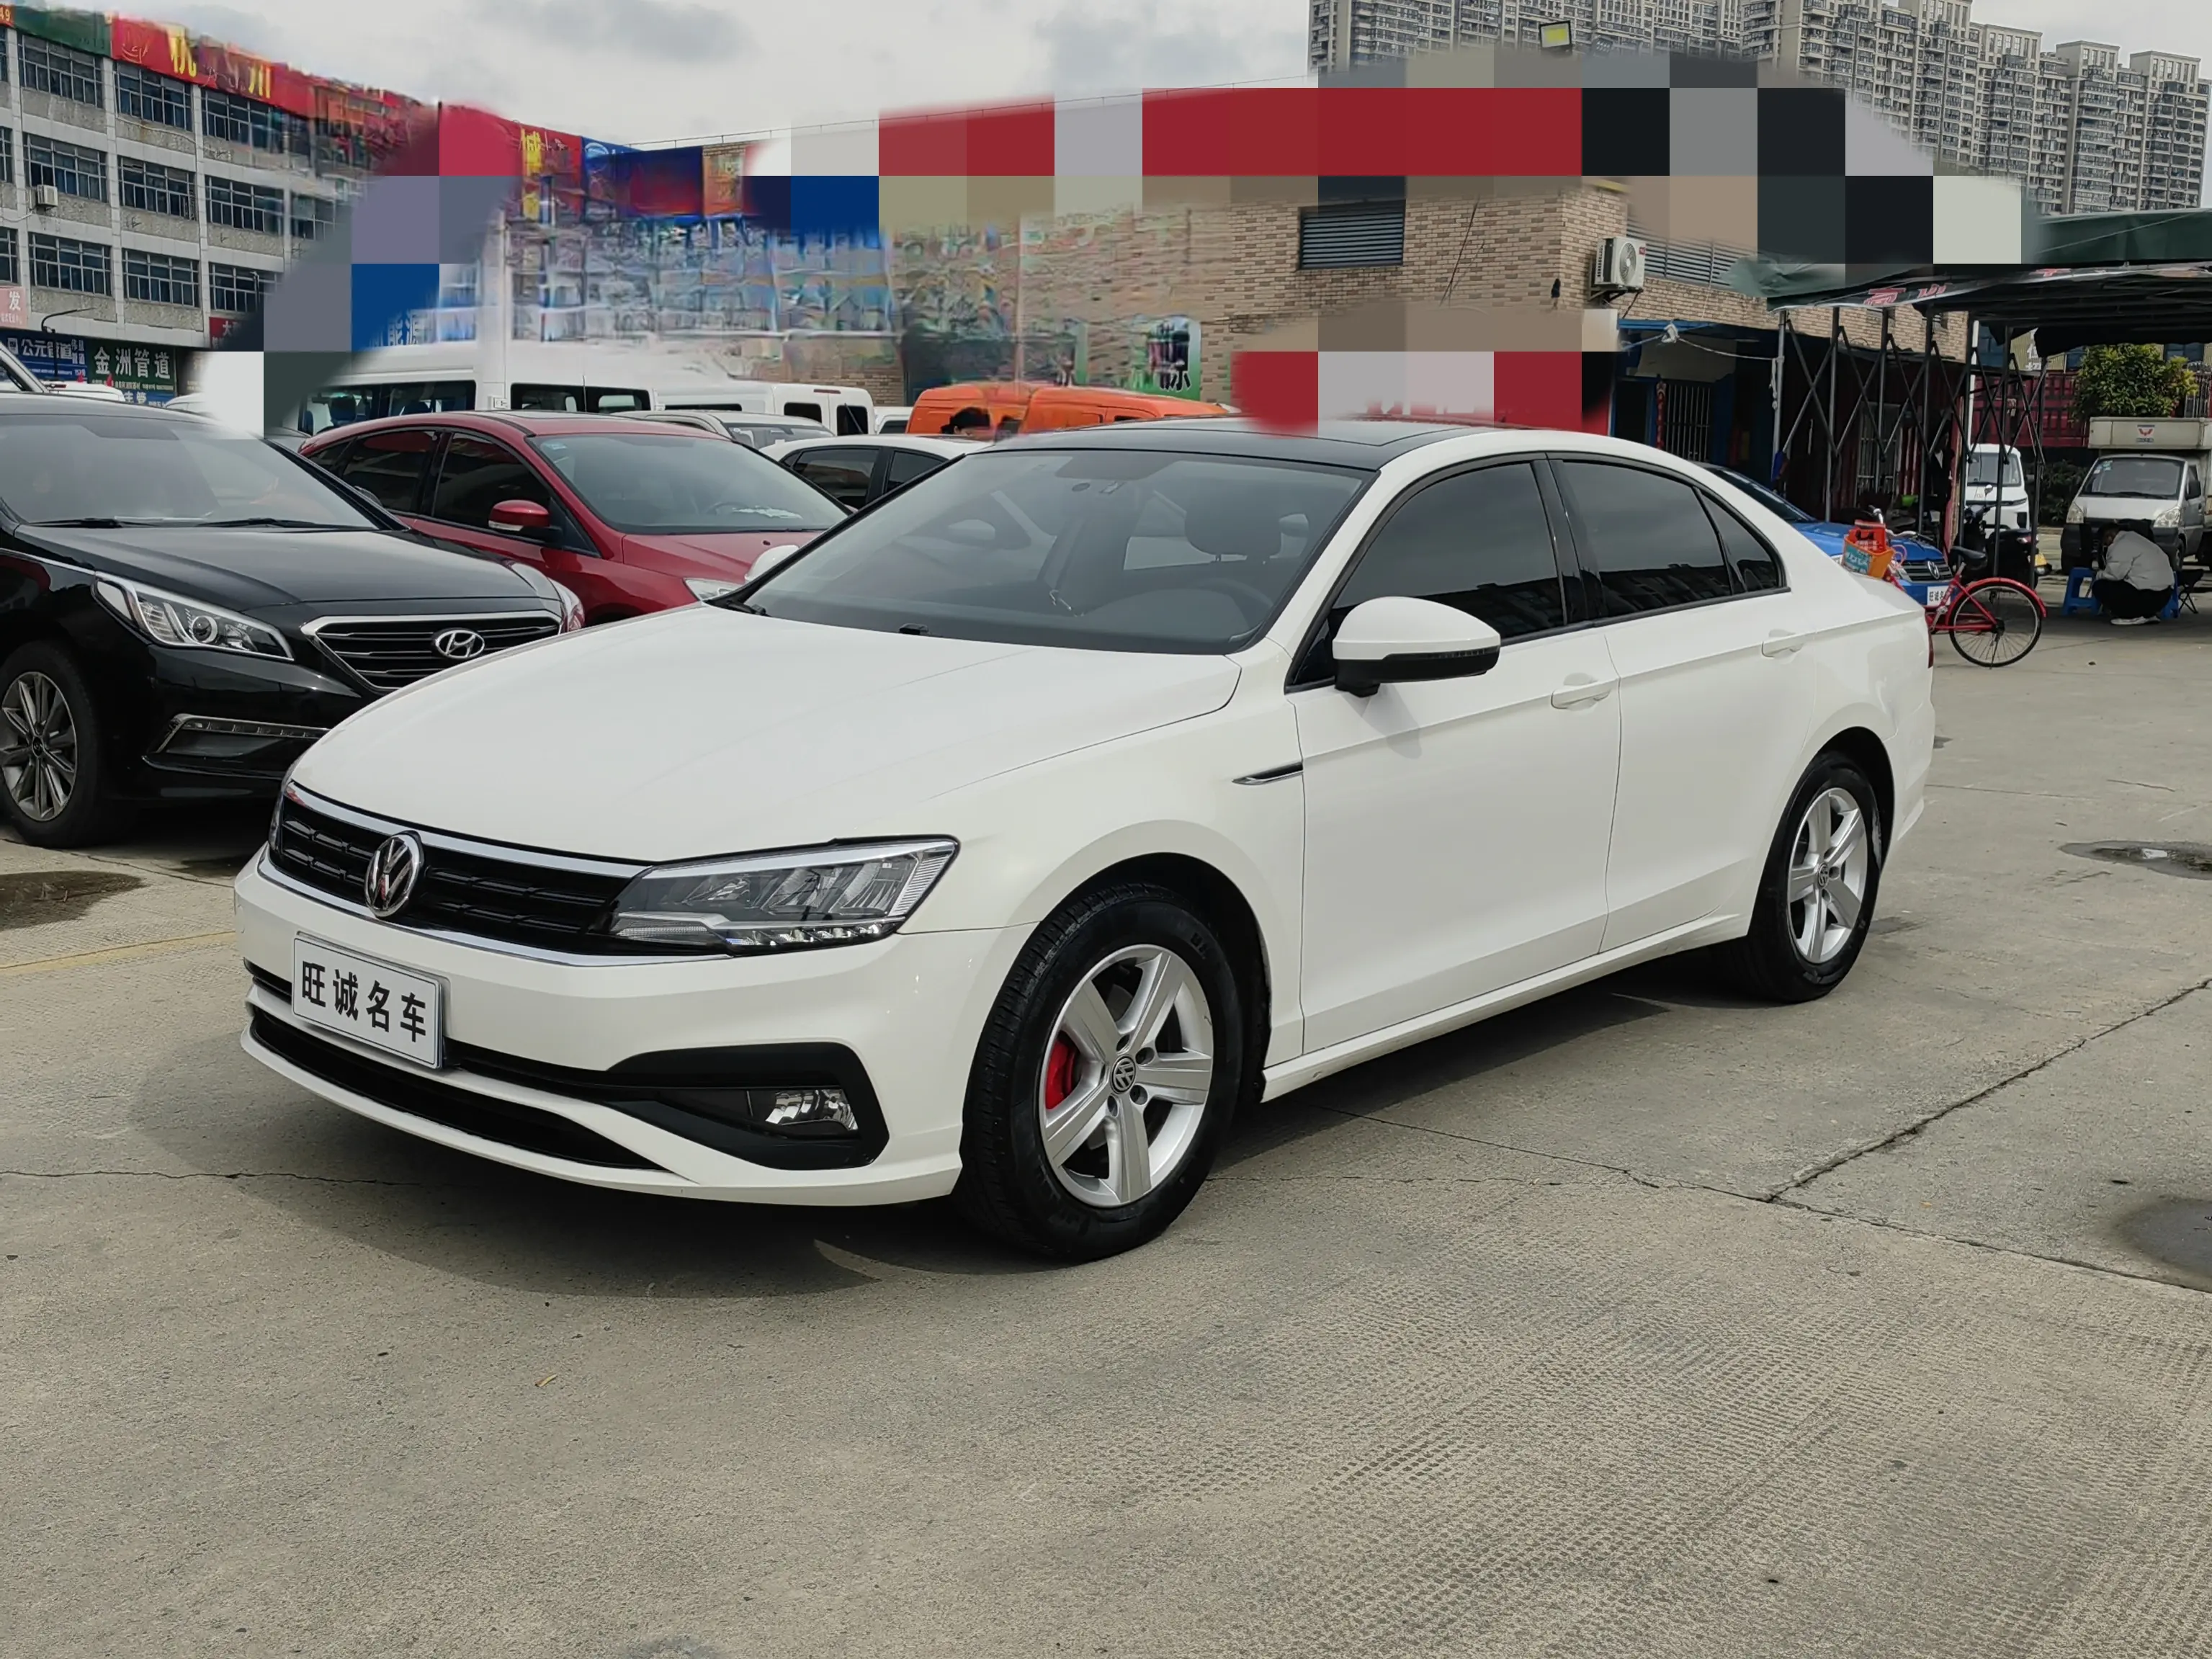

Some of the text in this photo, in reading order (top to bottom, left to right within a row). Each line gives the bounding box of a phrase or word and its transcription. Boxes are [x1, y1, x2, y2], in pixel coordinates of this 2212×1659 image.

[94, 346, 171, 380] 金洲管道
[302, 960, 426, 1043] 旺诚名车
